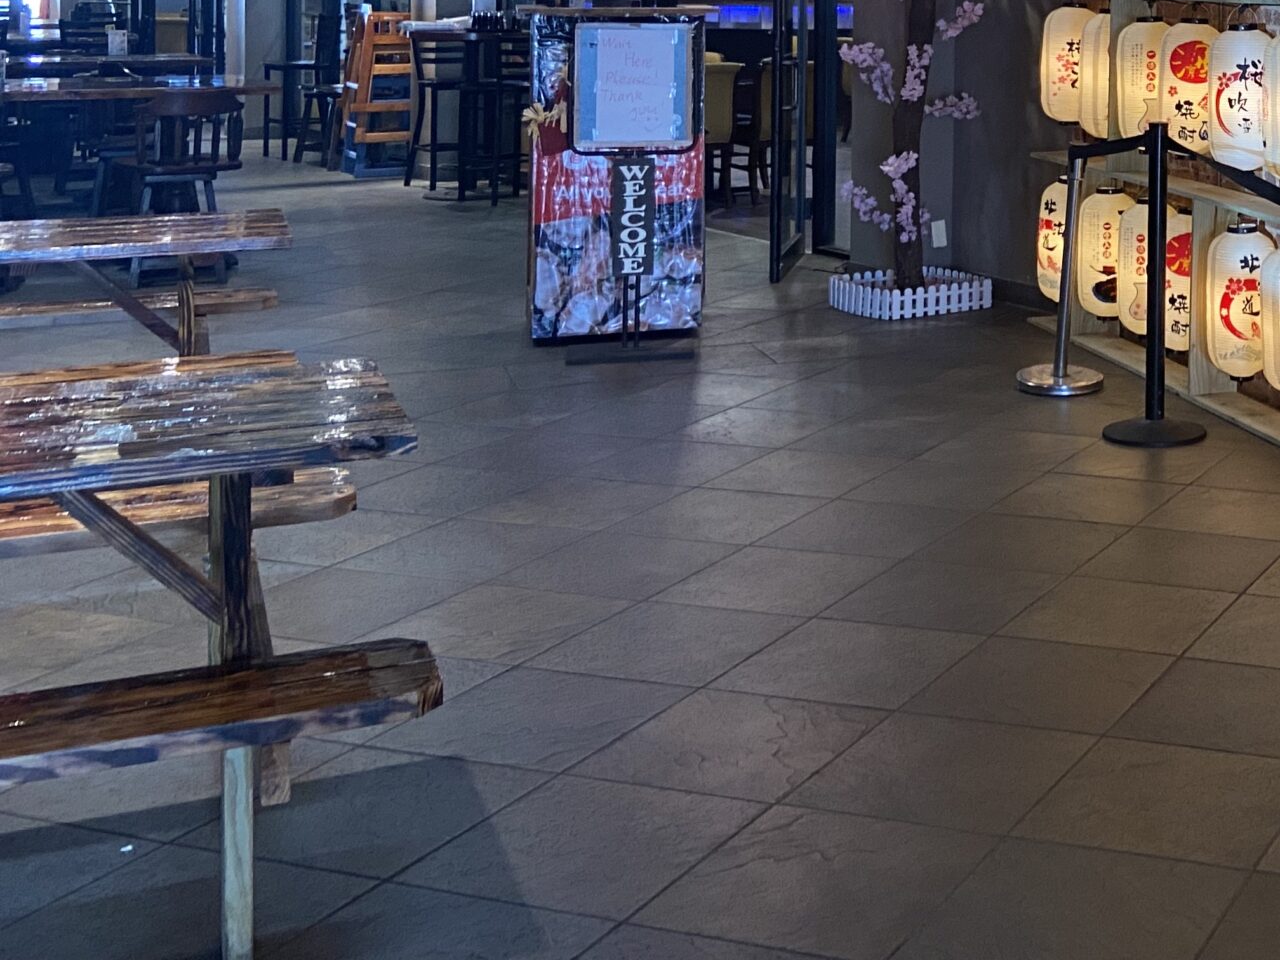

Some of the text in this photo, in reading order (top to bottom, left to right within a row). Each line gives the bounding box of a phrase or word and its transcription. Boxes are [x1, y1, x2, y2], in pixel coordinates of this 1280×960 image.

[602, 37, 632, 49] Wait
[624, 50, 653, 68] Here
[600, 87, 643, 103] Thank
[618, 165, 650, 274] WELCOME
